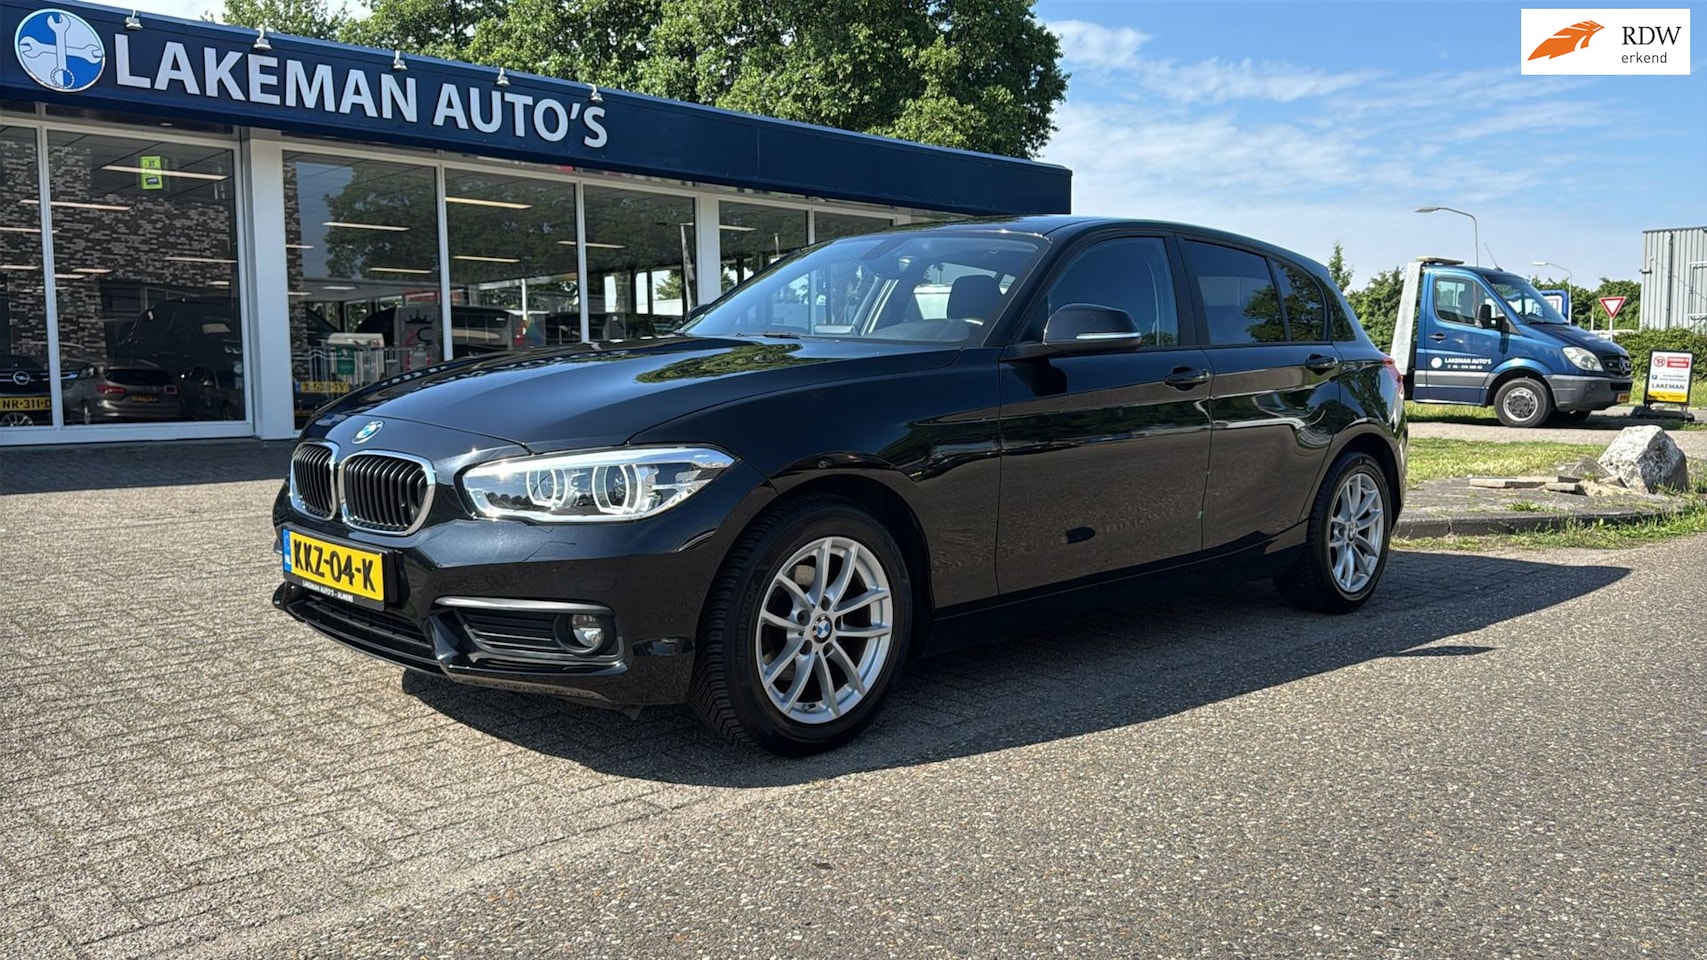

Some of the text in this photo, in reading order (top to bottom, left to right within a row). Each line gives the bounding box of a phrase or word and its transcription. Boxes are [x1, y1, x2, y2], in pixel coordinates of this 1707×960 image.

[114, 33, 608, 148] LAKEMAN AUTO'S
[293, 538, 377, 593] KKZ-04-K
